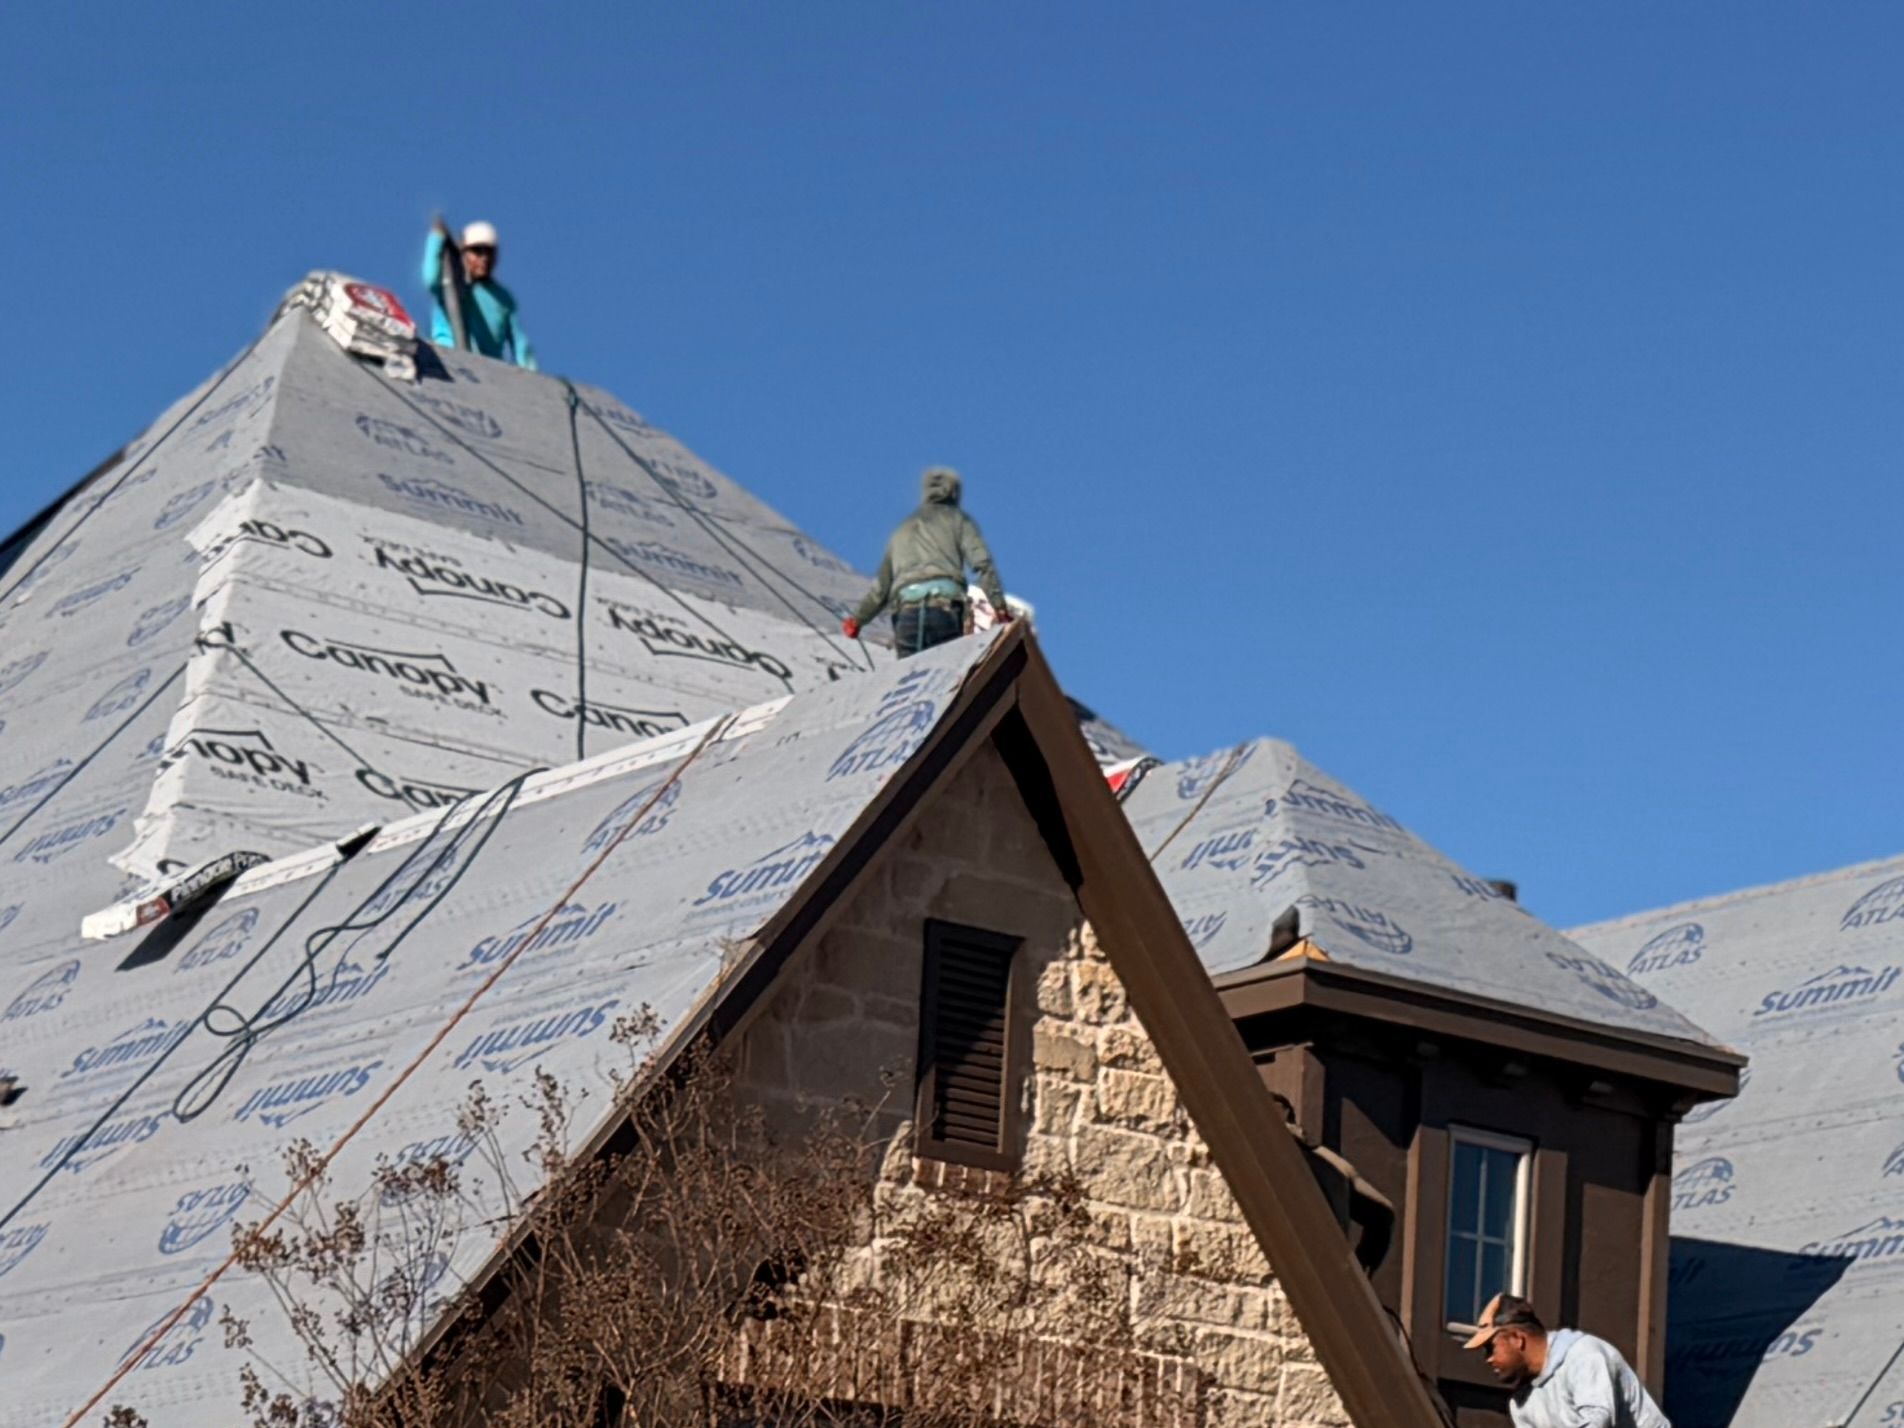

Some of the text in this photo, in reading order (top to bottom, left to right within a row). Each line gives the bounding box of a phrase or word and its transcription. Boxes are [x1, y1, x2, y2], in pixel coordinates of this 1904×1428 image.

[375, 547, 571, 619] Canopy
[280, 630, 492, 705] Canopy
[1627, 945, 1708, 977] ATLAS
